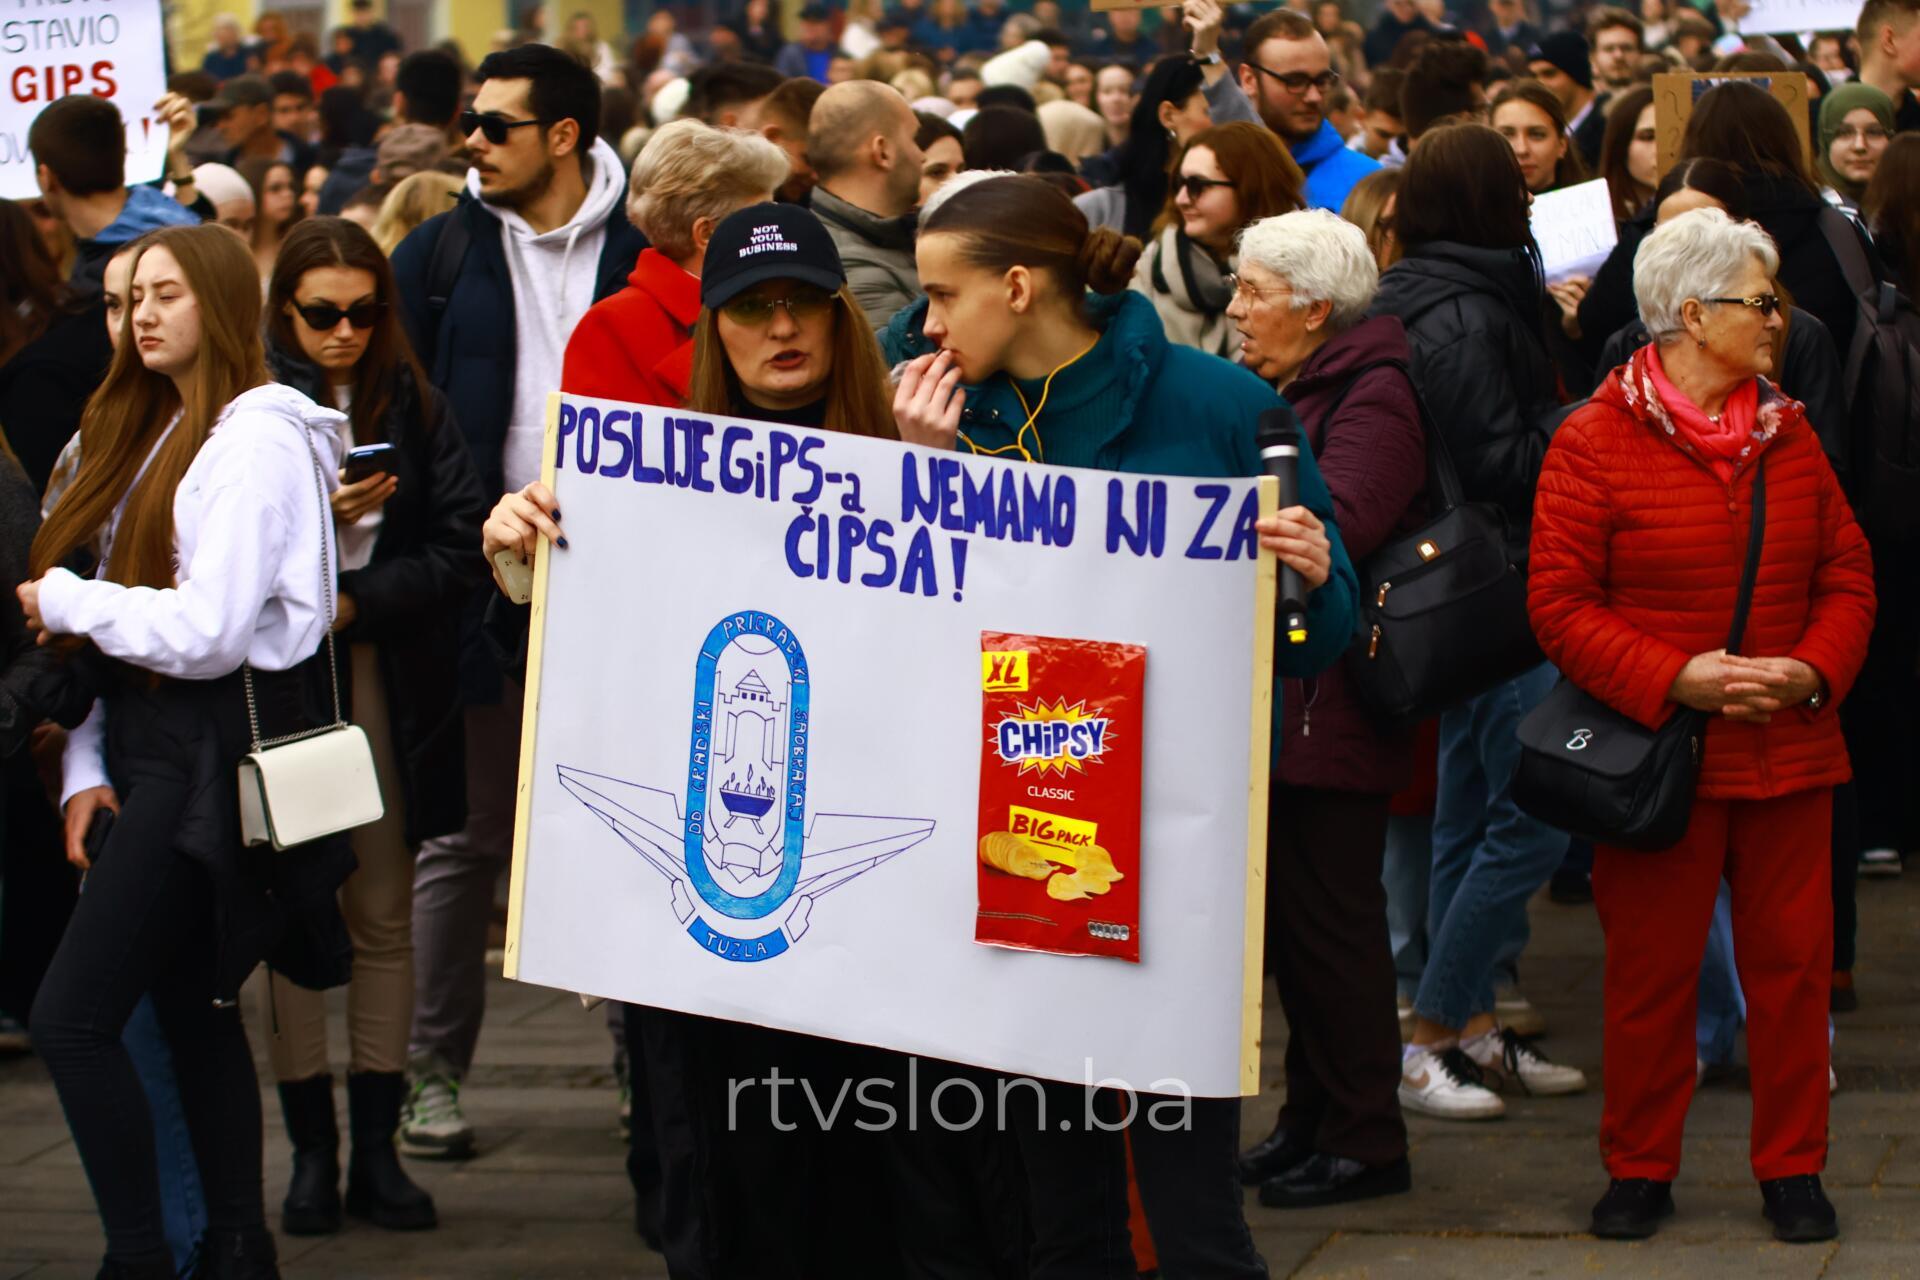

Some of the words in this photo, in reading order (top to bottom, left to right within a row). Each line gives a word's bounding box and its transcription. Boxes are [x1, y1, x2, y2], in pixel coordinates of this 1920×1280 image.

[2, 14, 120, 53] STAVIO
[11, 60, 118, 103] GIPS
[750, 233, 784, 244] YOUR
[752, 225, 779, 236] NOT
[739, 242, 798, 258] BUSINESS
[556, 404, 715, 493] POSLIJE
[902, 451, 1076, 547] NEMAMO
[1106, 478, 1167, 558] NI
[1184, 485, 1258, 561] ZA
[986, 655, 1020, 684] XL
[1027, 786, 1076, 801] CLASSIC
[1012, 814, 1055, 840] BIG
[1056, 829, 1092, 847] PACK
[707, 932, 768, 957] TUZLA
